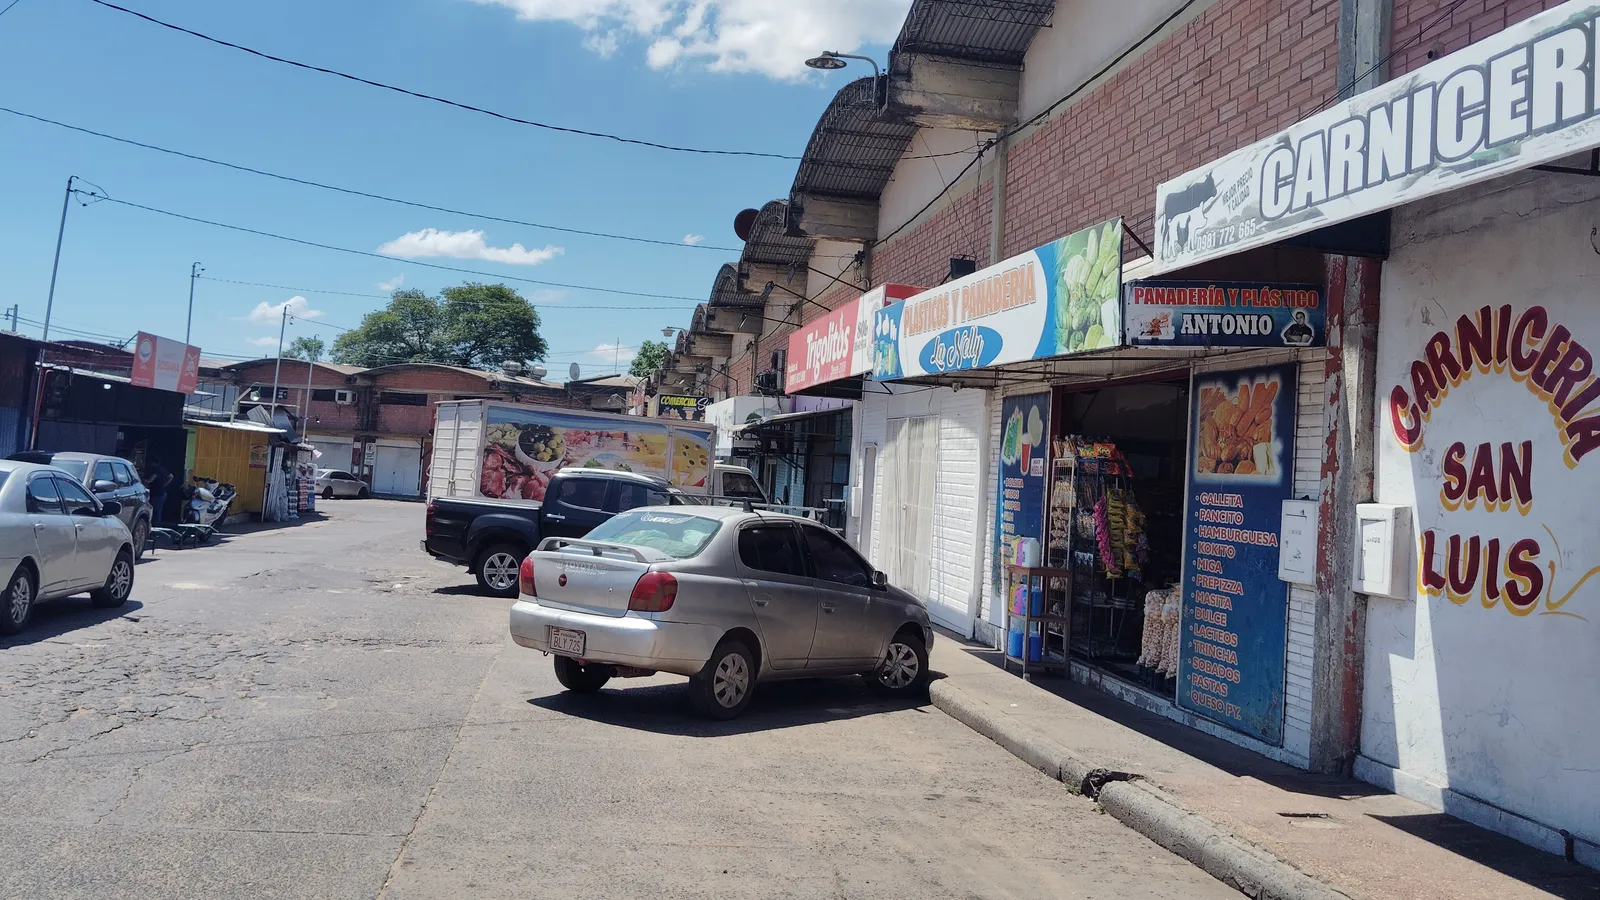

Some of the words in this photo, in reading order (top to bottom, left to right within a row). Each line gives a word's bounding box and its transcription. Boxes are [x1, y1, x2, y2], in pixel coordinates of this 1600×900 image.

[1260, 13, 1600, 222] CARNICER
[1222, 184, 1237, 206] MEJOR
[1236, 167, 1253, 190] PRECIO
[1231, 185, 1250, 211] CALIDAD
[1197, 231, 1216, 252] 0981
[1219, 225, 1235, 245] 772
[1238, 218, 1257, 238] 665
[903, 292, 950, 339] PLASTICOS
[951, 288, 960, 326] Y
[961, 261, 1037, 324] PANADERIA
[1134, 285, 1226, 307] PANADERÍA
[1229, 289, 1239, 307] Y
[1241, 286, 1319, 309] PLÁSTICO
[1180, 313, 1274, 336] ANTONIO
[806, 316, 850, 382] Trigolitos
[930, 336, 946, 371] La
[947, 325, 984, 369] Nelly
[1389, 303, 1600, 468] CARNICERIA
[660, 395, 697, 407] COMERCIAL
[1441, 440, 1533, 516] SAN
[1200, 492, 1243, 508] GALLETA
[1199, 508, 1244, 525] PANCITO
[1198, 525, 1278, 547] HAMBURGUESA
[1197, 541, 1236, 559] KOKITO
[565, 560, 597, 570] TOYOTA
[1196, 557, 1223, 574] MIGA
[1418, 529, 1544, 616] LUIS
[1195, 573, 1244, 595] PREPIZZA
[1195, 590, 1233, 611] MASITA
[1194, 606, 1227, 627] DULCE
[553, 636, 568, 649] BLY
[569, 638, 581, 652] 725
[1193, 623, 1238, 648] LACTEOS
[1192, 640, 1238, 666] TRINCHA
[1192, 657, 1240, 684] SOBADOS
[1191, 672, 1228, 697] PASTAS
[1191, 690, 1225, 713] QUESO
